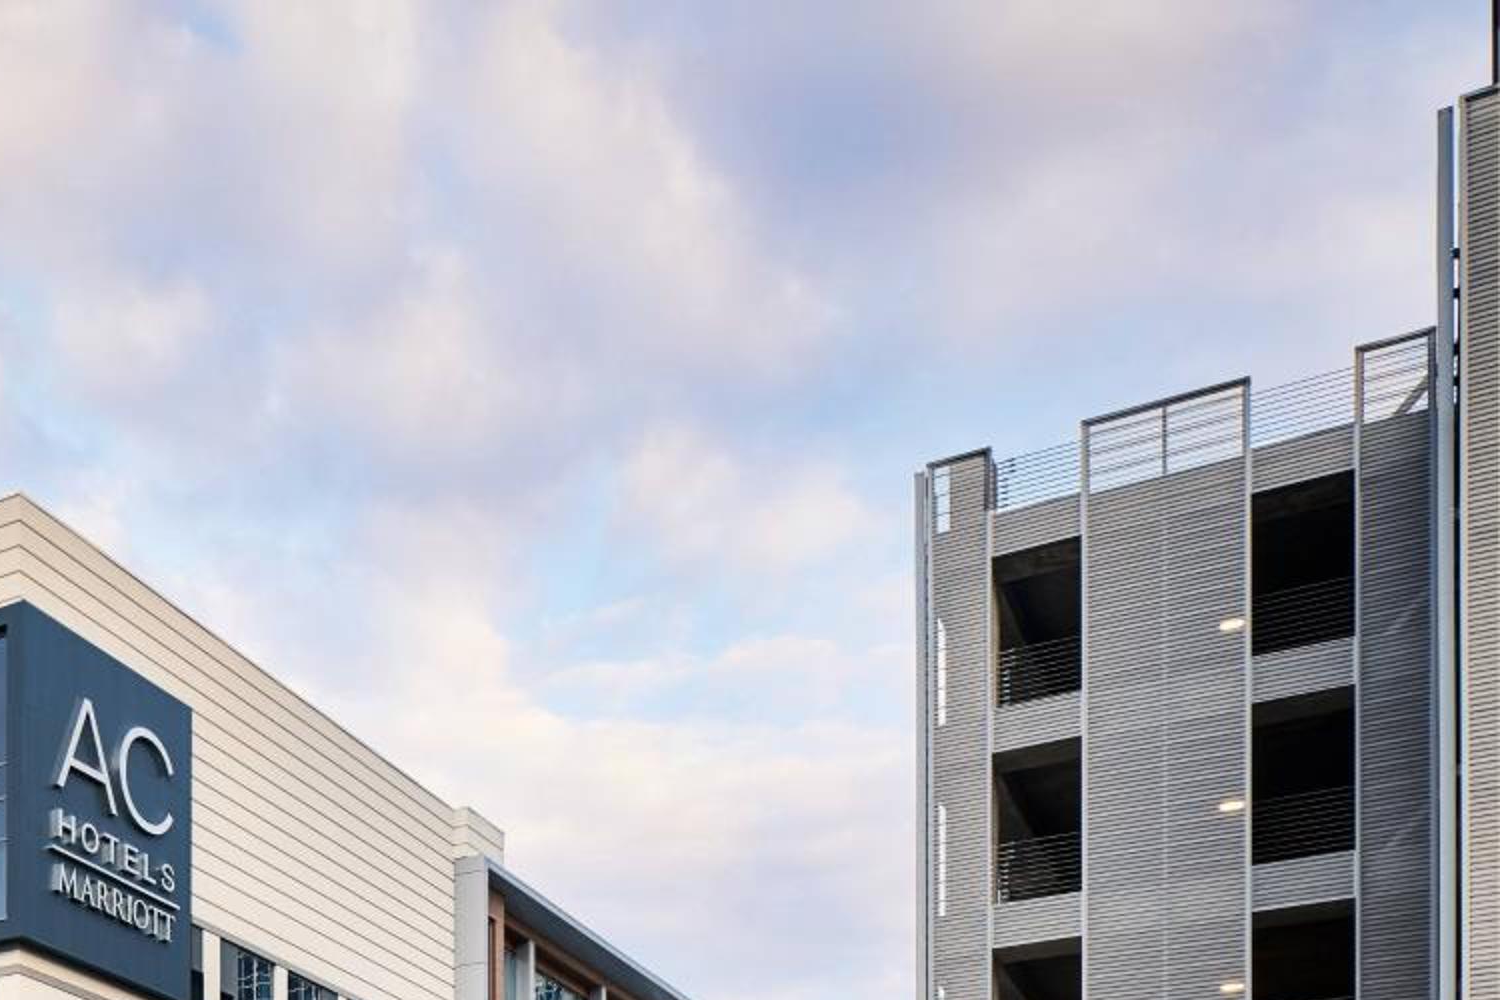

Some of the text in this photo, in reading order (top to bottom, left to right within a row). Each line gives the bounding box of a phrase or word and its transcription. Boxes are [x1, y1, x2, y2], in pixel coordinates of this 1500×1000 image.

[55, 697, 174, 836] AC
[51, 808, 176, 892] HOTELS
[52, 862, 177, 943] MARRIOTT
